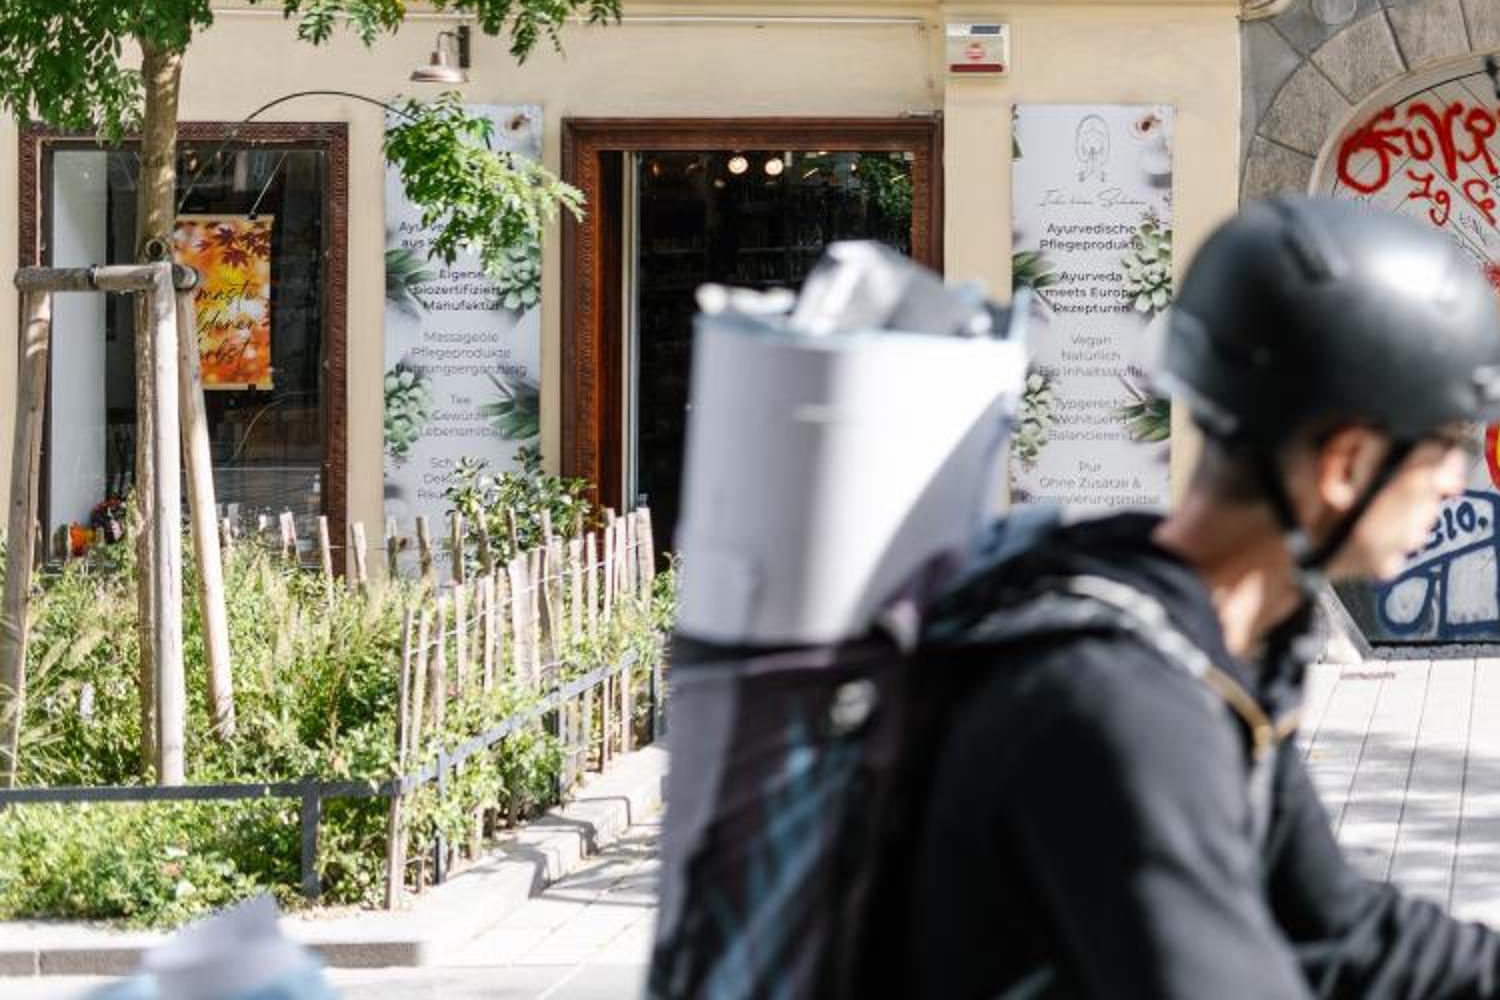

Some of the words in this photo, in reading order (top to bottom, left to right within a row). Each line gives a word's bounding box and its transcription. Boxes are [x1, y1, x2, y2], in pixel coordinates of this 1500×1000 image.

[1047, 224, 1137, 236] Ayurvedische
[1040, 239, 1145, 252] Pflegeprodukte
[1060, 272, 1123, 283] Ayurveda
[1045, 288, 1086, 296] meets
[424, 300, 500, 311] Manufaktur
[1053, 303, 1131, 314] Rezepturen
[1072, 335, 1112, 347] Vegan
[412, 348, 512, 360] Pflegeprodukte
[451, 395, 471, 405] Tee
[1079, 461, 1101, 472] Pur
